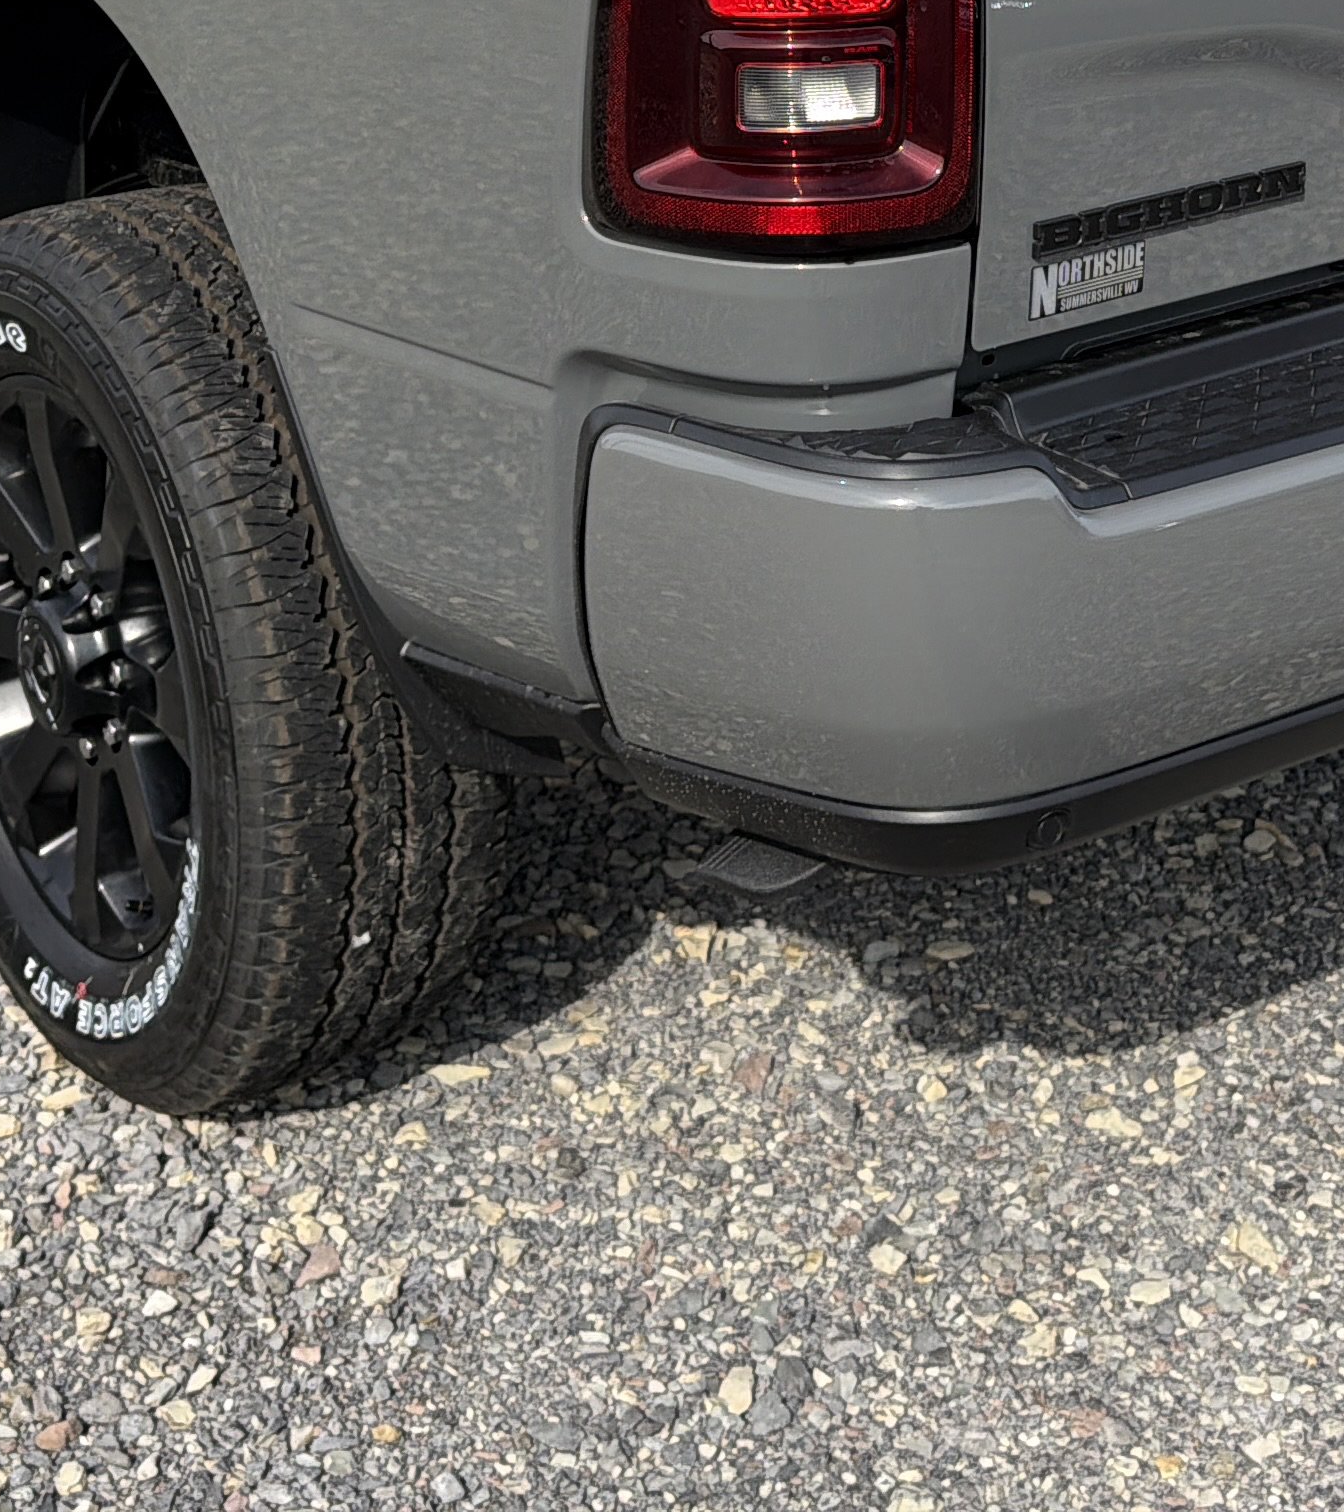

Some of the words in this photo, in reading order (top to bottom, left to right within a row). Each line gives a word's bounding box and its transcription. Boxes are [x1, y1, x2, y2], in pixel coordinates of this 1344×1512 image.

[1031, 160, 1306, 260] BIGHORN
[1030, 241, 1145, 320] NORTHSIDE
[1059, 283, 1123, 312] SUMMERSVILLE
[1124, 279, 1139, 295] WV
